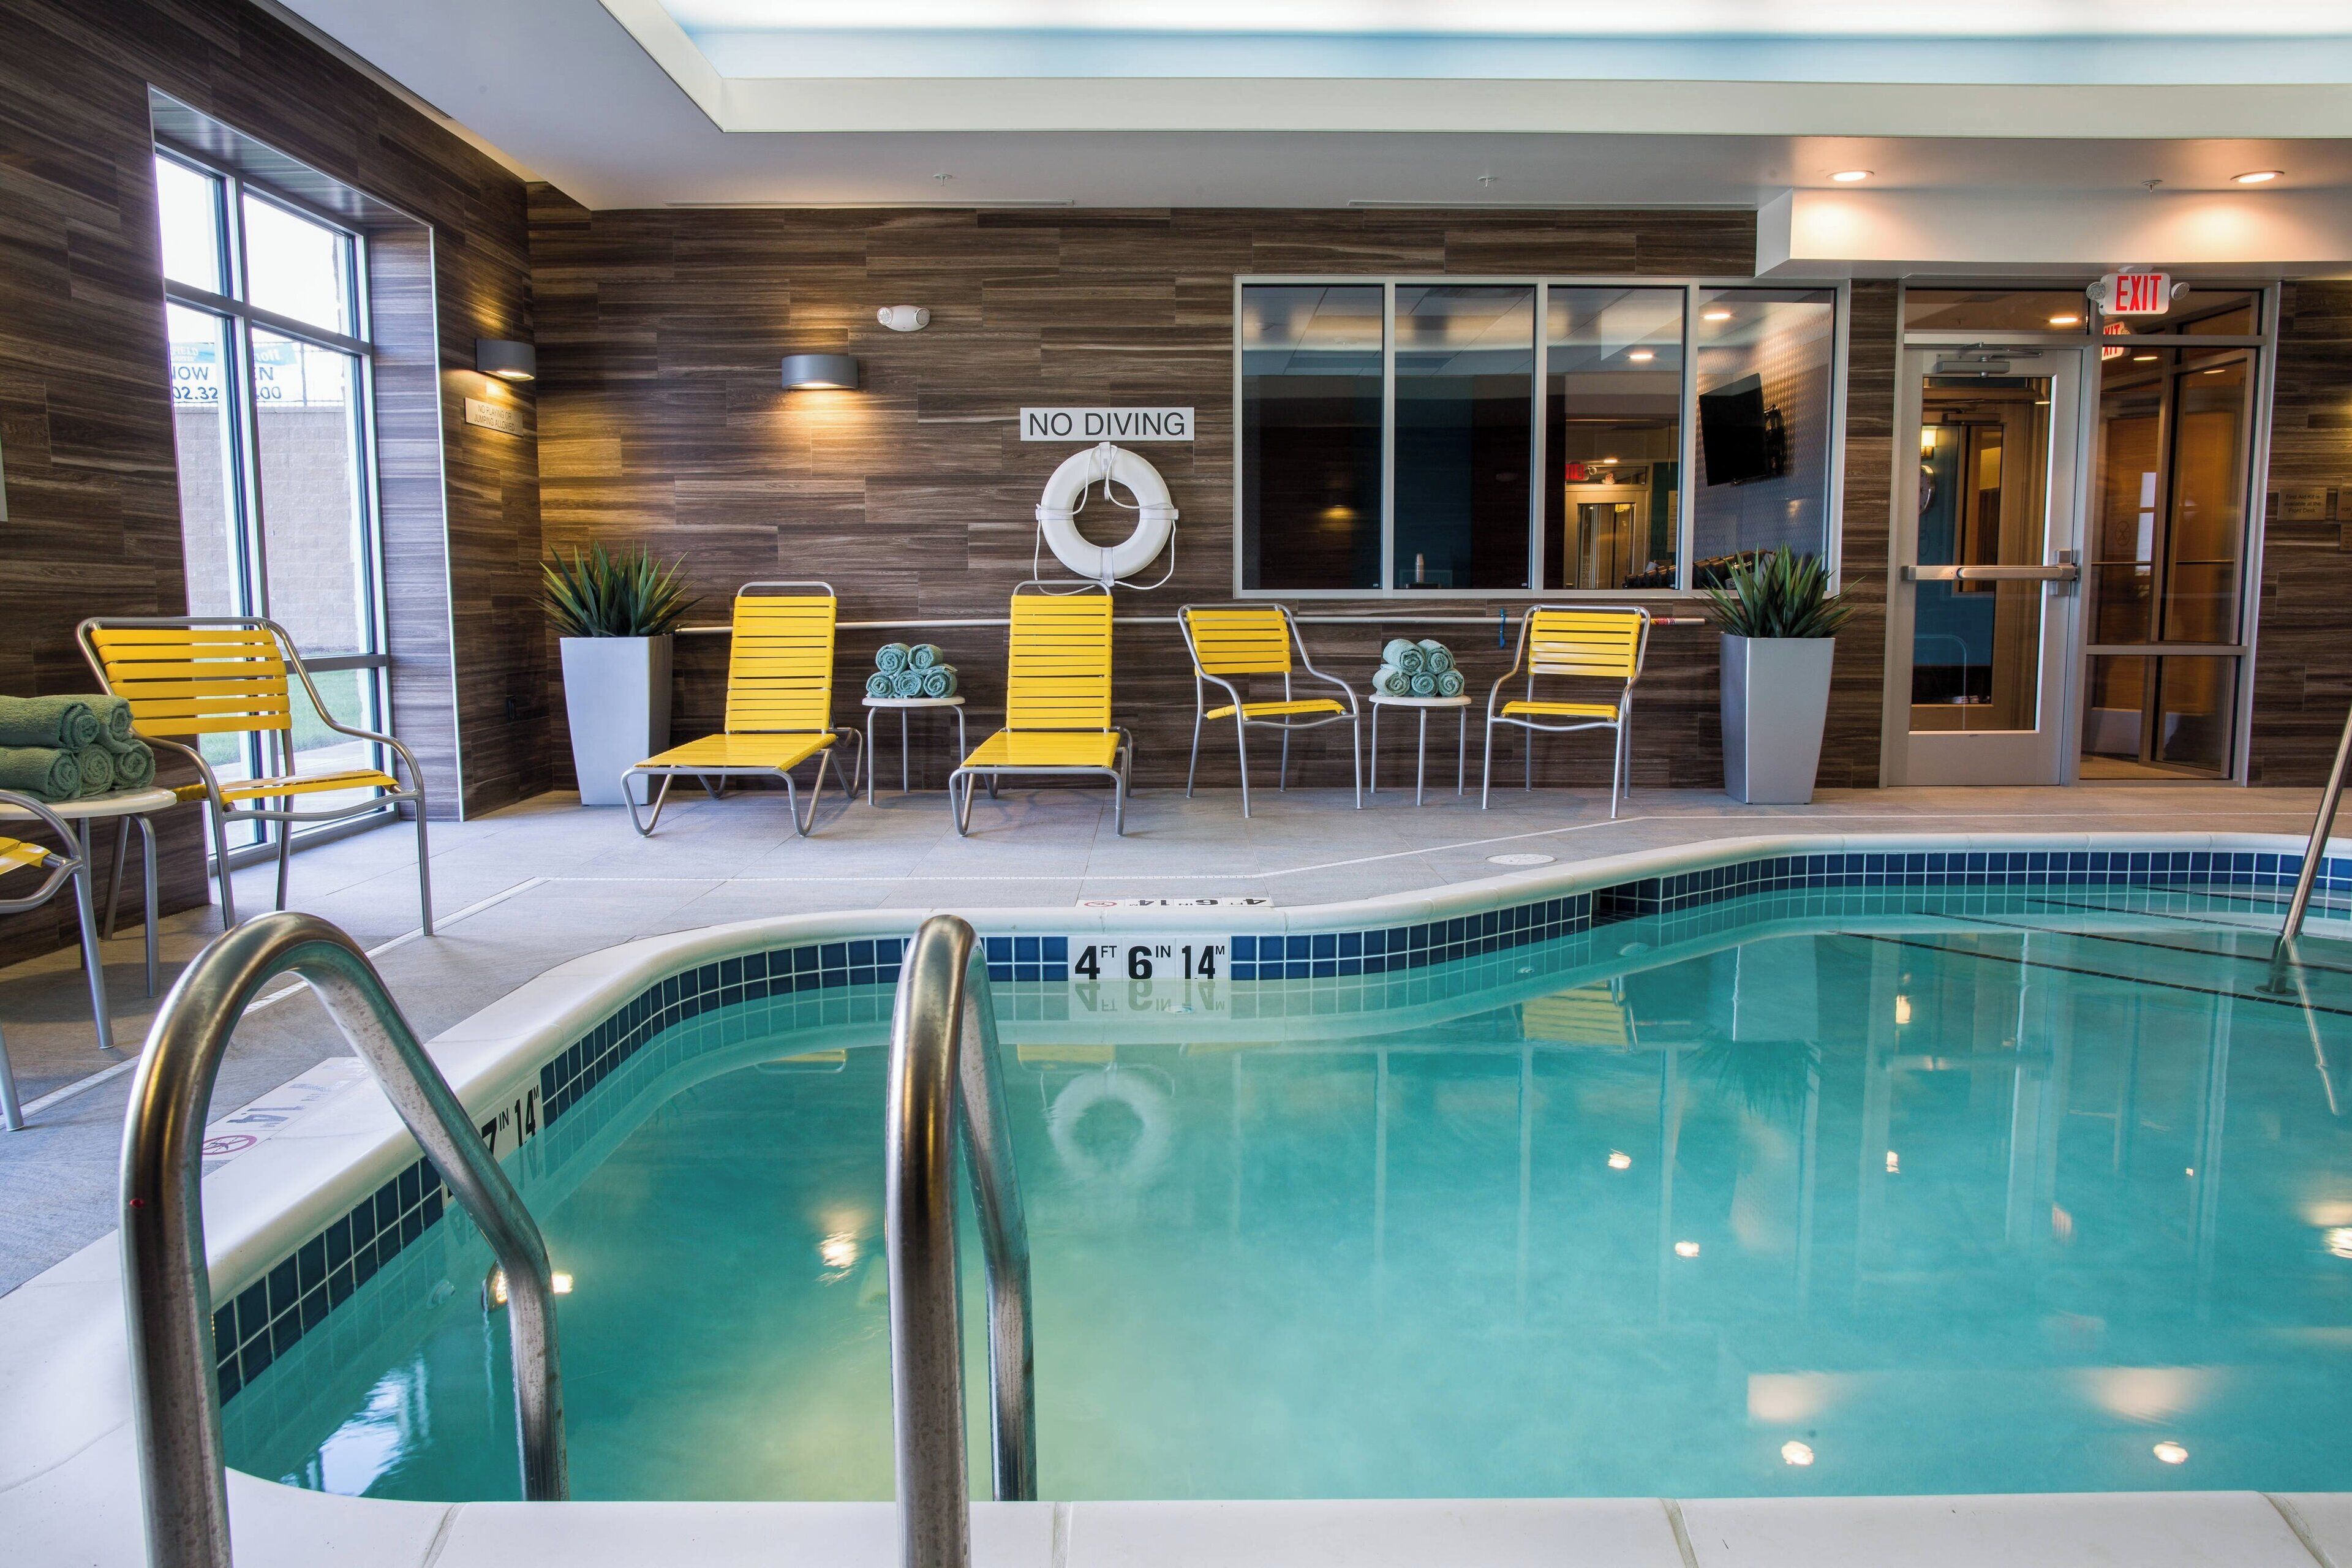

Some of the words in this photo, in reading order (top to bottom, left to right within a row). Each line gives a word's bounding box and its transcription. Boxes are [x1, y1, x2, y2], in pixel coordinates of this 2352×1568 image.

[2116, 275, 2162, 311] EXIT
[478, 404, 485, 413] NO
[505, 411, 512, 420] OR
[475, 414, 494, 426] JUMPING
[495, 420, 515, 431] ALLOWED
[1030, 413, 1072, 436] NO
[1085, 412, 1185, 435] DIVING
